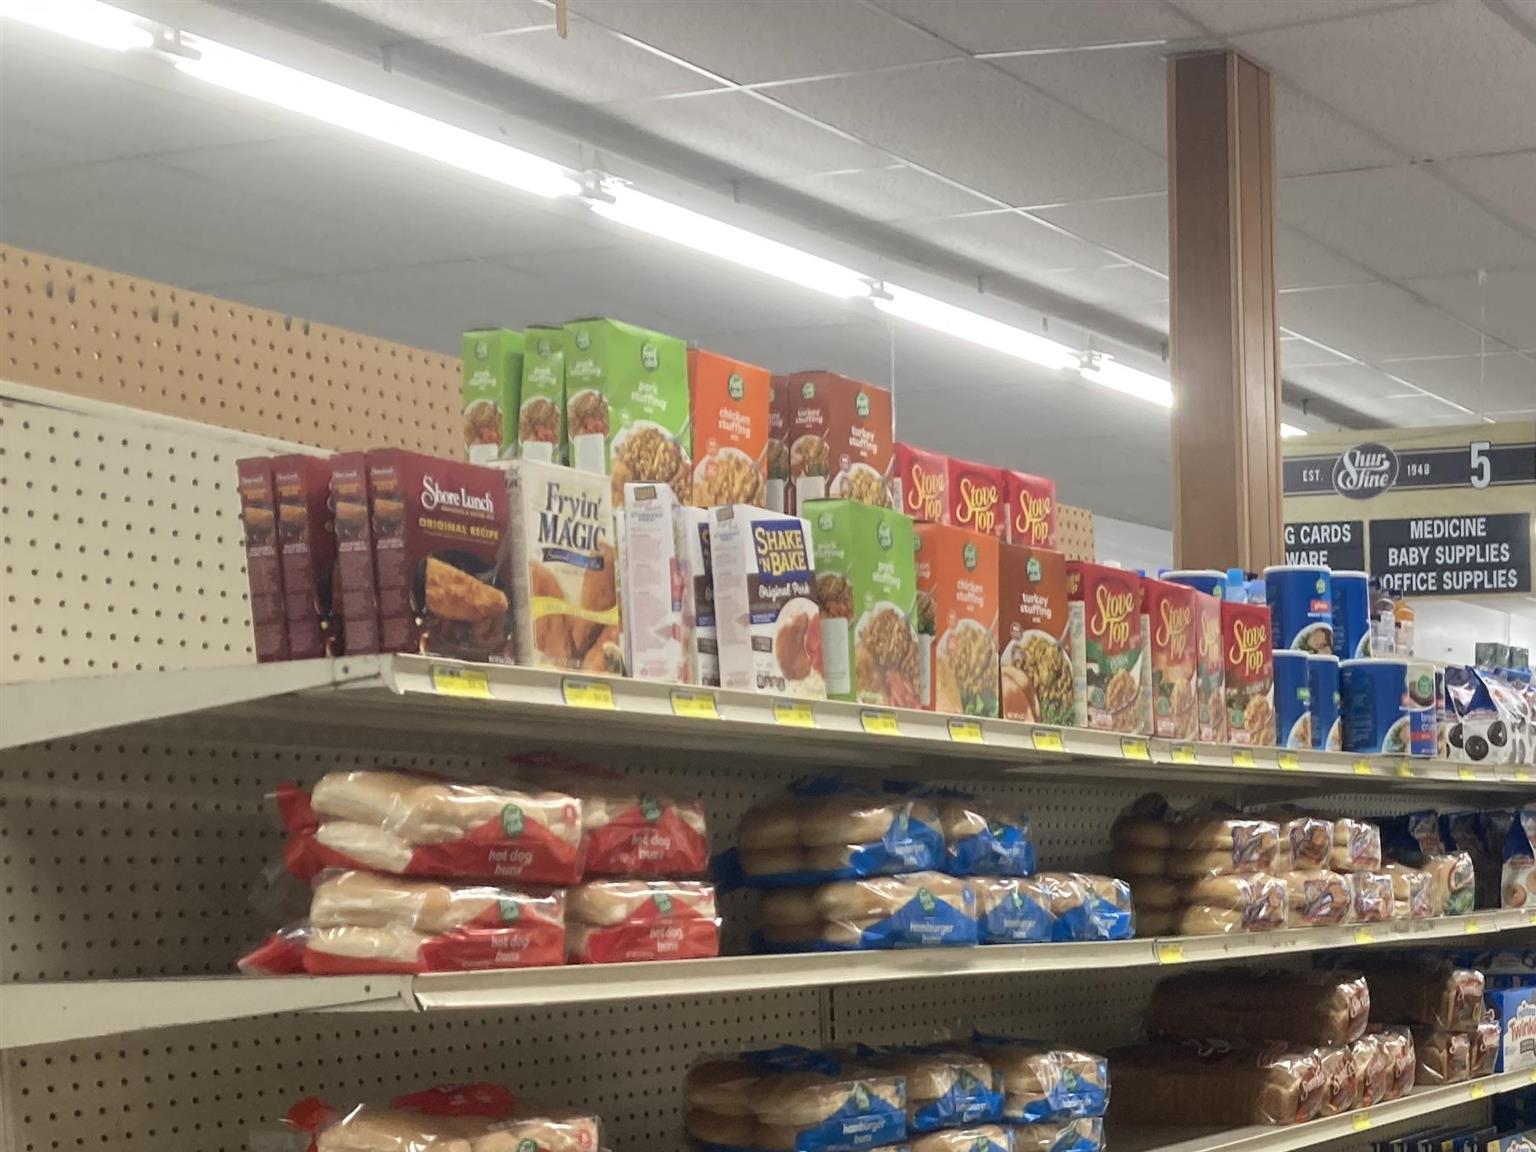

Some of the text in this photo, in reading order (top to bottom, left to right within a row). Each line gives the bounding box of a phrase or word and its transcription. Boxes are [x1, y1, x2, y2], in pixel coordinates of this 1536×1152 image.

[1303, 469, 1324, 482] EST.
[1407, 464, 1430, 476] 1948
[1470, 442, 1491, 488] 5
[421, 475, 460, 509] Shore
[460, 488, 494, 513] Lunch
[908, 464, 945, 510] Stove
[923, 497, 942, 520] Top
[956, 478, 998, 525] Stove
[1015, 490, 1051, 533] Stove
[418, 517, 499, 540] ORIGINAL RECIPE
[537, 512, 606, 550] MAGIC
[974, 506, 995, 534] Top
[1028, 518, 1049, 545] Top
[1300, 525, 1352, 543] CARDS
[1410, 518, 1487, 539] MEDICINE
[755, 527, 803, 555] SHAKE
[1388, 544, 1511, 566] BABY SUPPLIES
[769, 551, 807, 576] BAKE
[758, 582, 791, 602] Original
[1443, 569, 1518, 589] SUPPLIES
[1020, 604, 1052, 620] stuffing
[1022, 592, 1049, 608] turkey
[1091, 585, 1134, 636] Stove
[1105, 619, 1129, 649] Top
[1156, 598, 1191, 647] Stove
[1169, 631, 1186, 660] Top
[1229, 619, 1267, 665] Stove
[1244, 648, 1264, 677] Top
